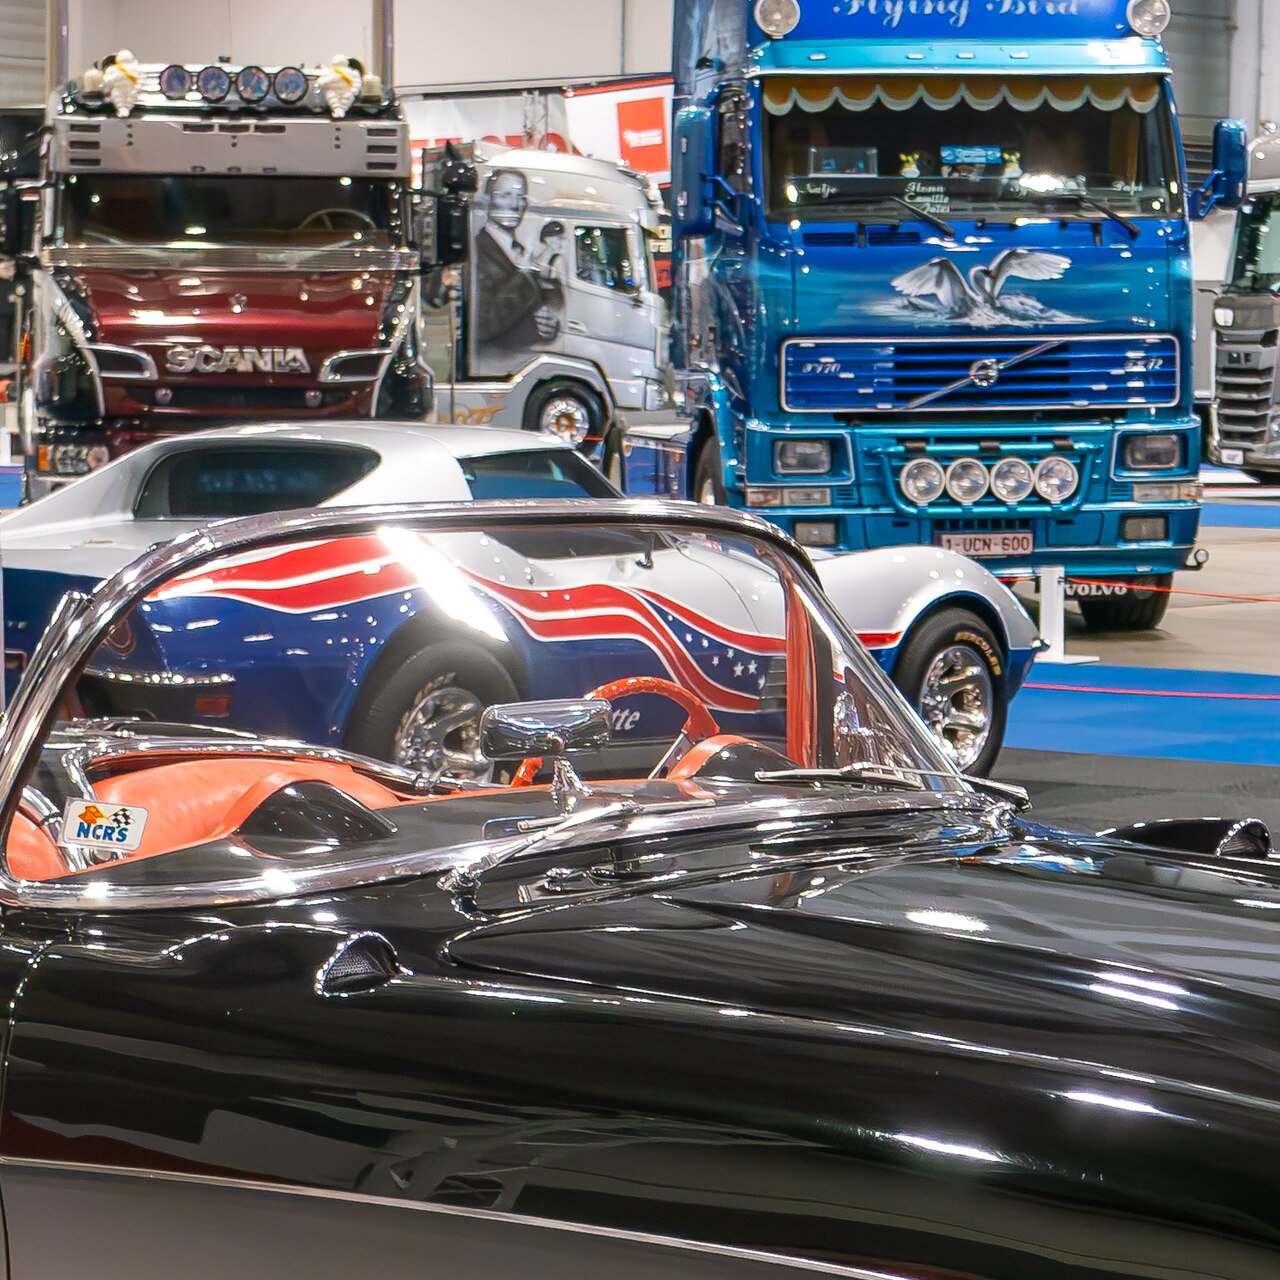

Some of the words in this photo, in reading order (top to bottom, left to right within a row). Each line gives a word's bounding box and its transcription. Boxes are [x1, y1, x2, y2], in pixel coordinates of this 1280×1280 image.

[166, 345, 311, 373] SCANIA
[1066, 583, 1128, 596] VOLVO
[76, 822, 129, 843] NCRS
